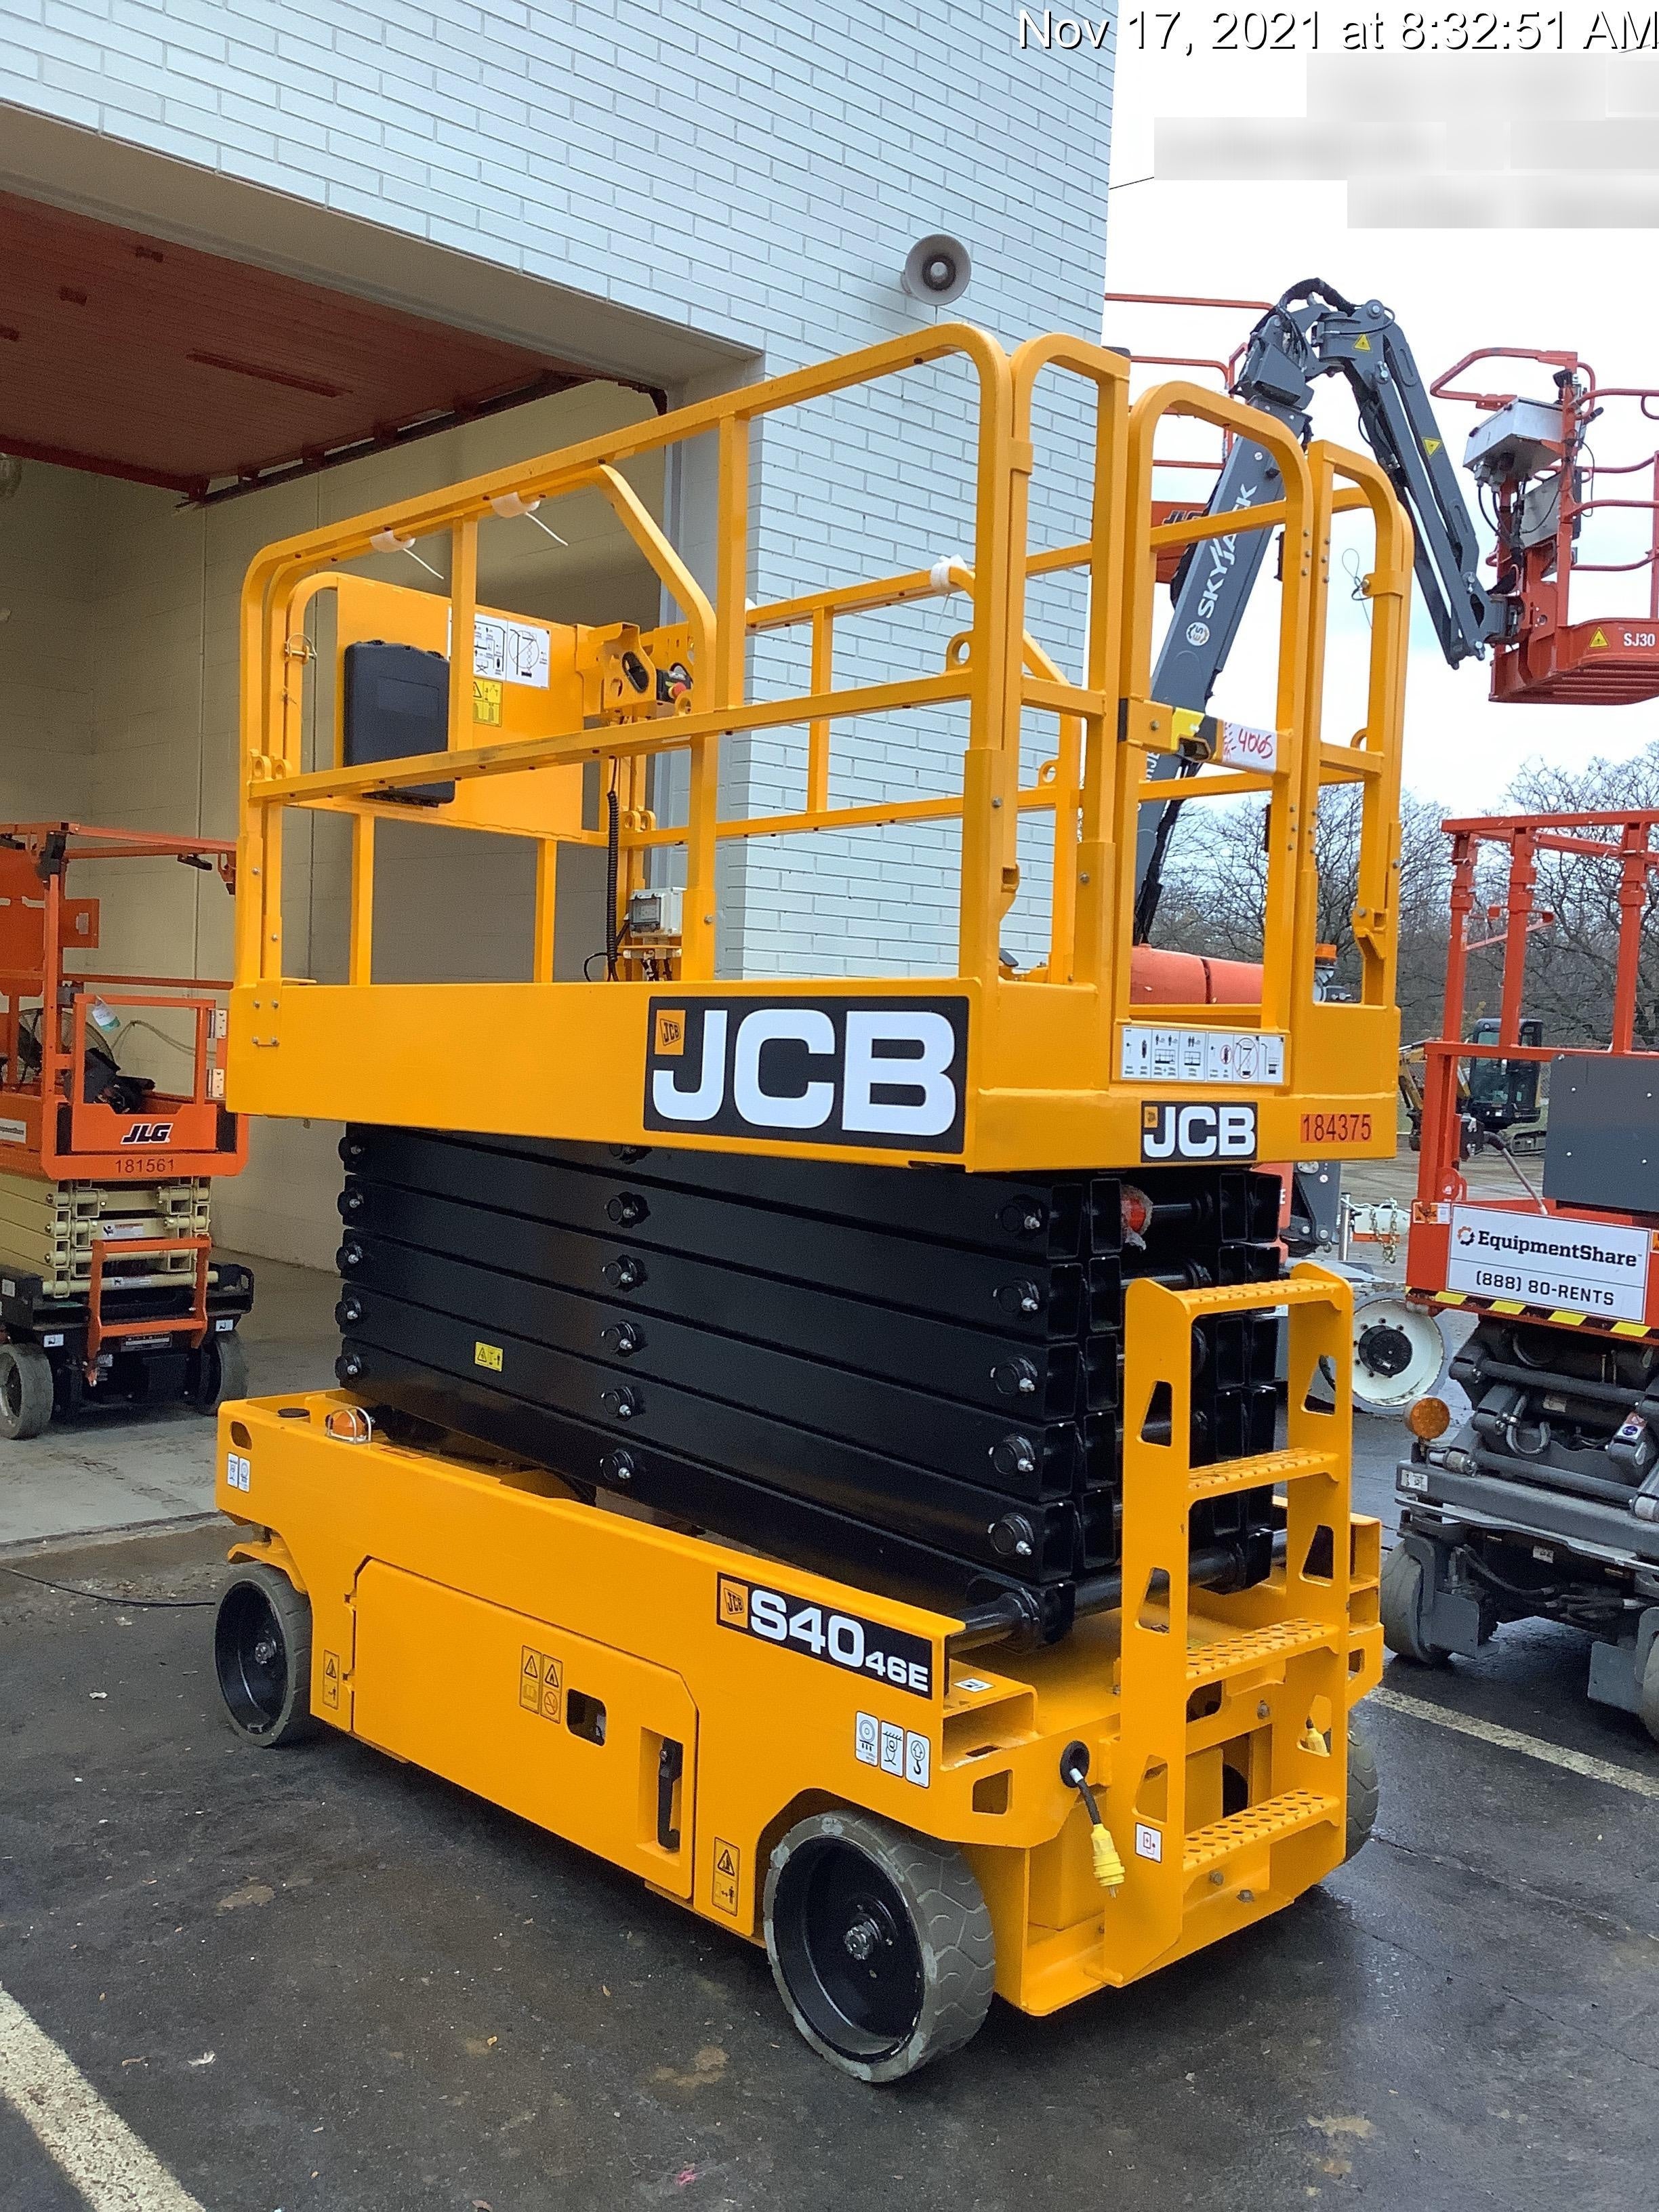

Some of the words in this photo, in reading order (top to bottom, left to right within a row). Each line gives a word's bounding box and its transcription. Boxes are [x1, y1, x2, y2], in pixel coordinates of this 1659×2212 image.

[1623, 632, 1656, 647] SJ30
[662, 1020, 680, 1044] JCB
[653, 1008, 957, 1136] JCB
[121, 1123, 173, 1144] JLG
[1143, 1105, 1256, 1158] JCB
[1303, 1113, 1372, 1142] 184375
[115, 1158, 174, 1173] 181561
[1478, 1230, 1637, 1267] EquipmentShare
[1475, 1270, 1522, 1291] (888)
[1528, 1279, 1615, 1306] 80-RENTS
[726, 1590, 744, 1613] JCB
